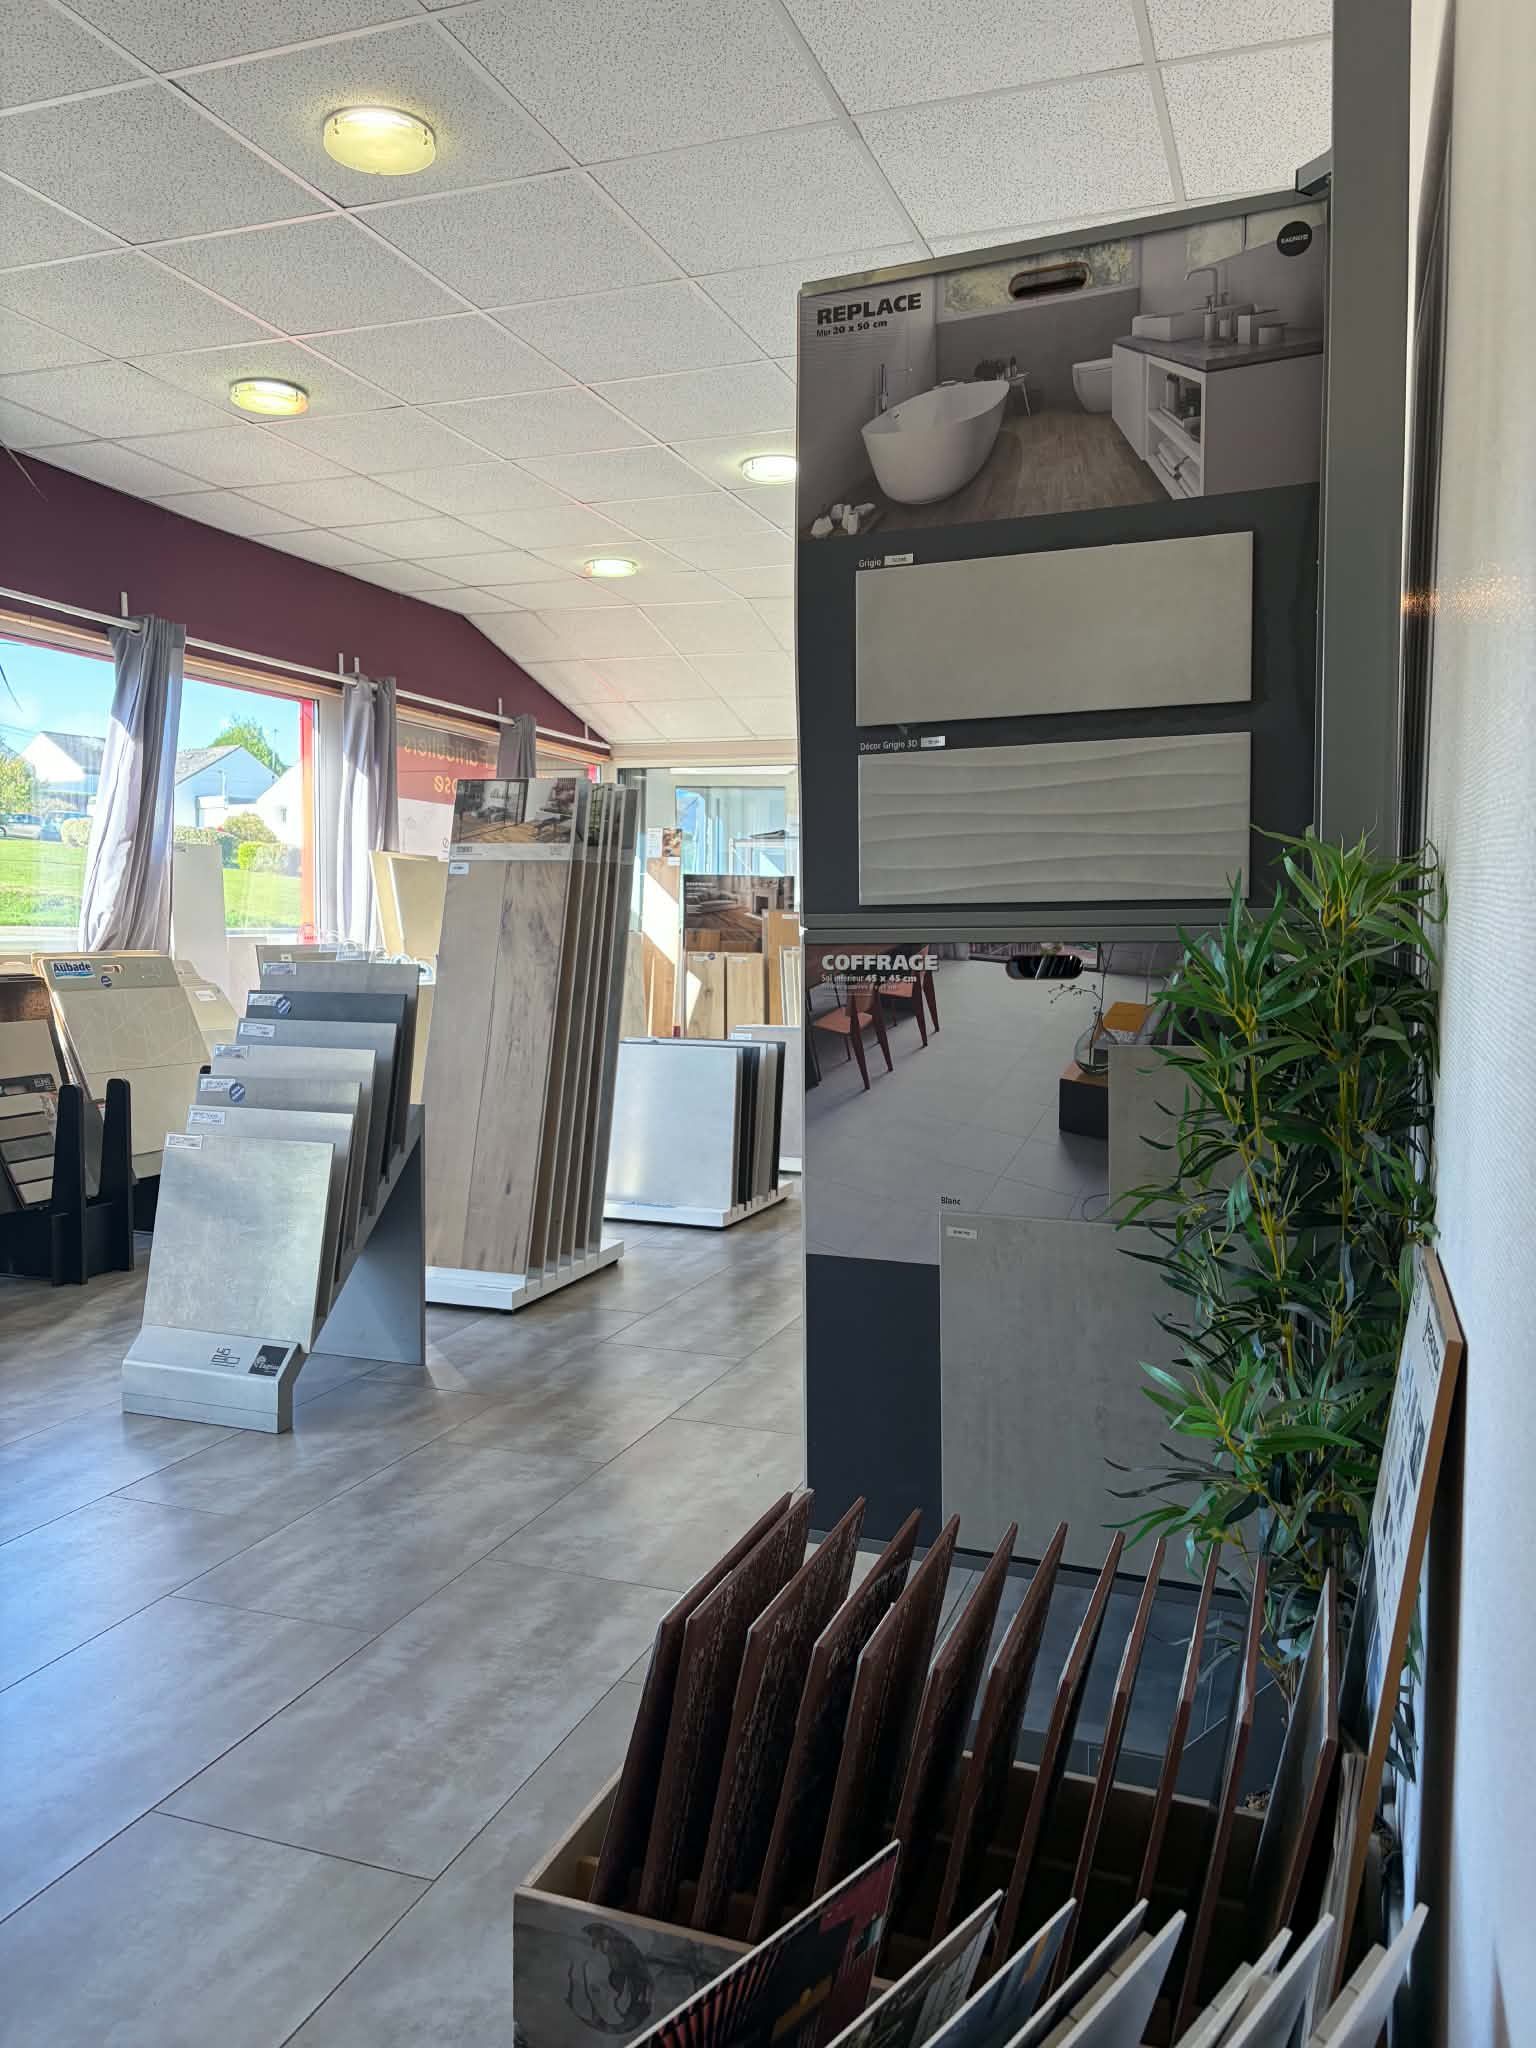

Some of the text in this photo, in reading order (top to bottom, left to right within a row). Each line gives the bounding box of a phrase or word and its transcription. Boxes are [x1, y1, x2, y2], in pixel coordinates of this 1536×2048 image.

[817, 292, 922, 325] REPLACE
[833, 326, 845, 335] 20
[857, 321, 870, 331] 50
[873, 320, 888, 328] cm
[858, 559, 881, 569] Grigio
[882, 740, 906, 751] Grigio
[907, 739, 918, 749] 3D
[53, 961, 93, 972] Aubade
[821, 954, 939, 971] COFFRAGE
[865, 973, 878, 983] 45
[889, 973, 901, 983] 45
[903, 975, 917, 984] cm
[940, 1196, 961, 1206] Blanc
